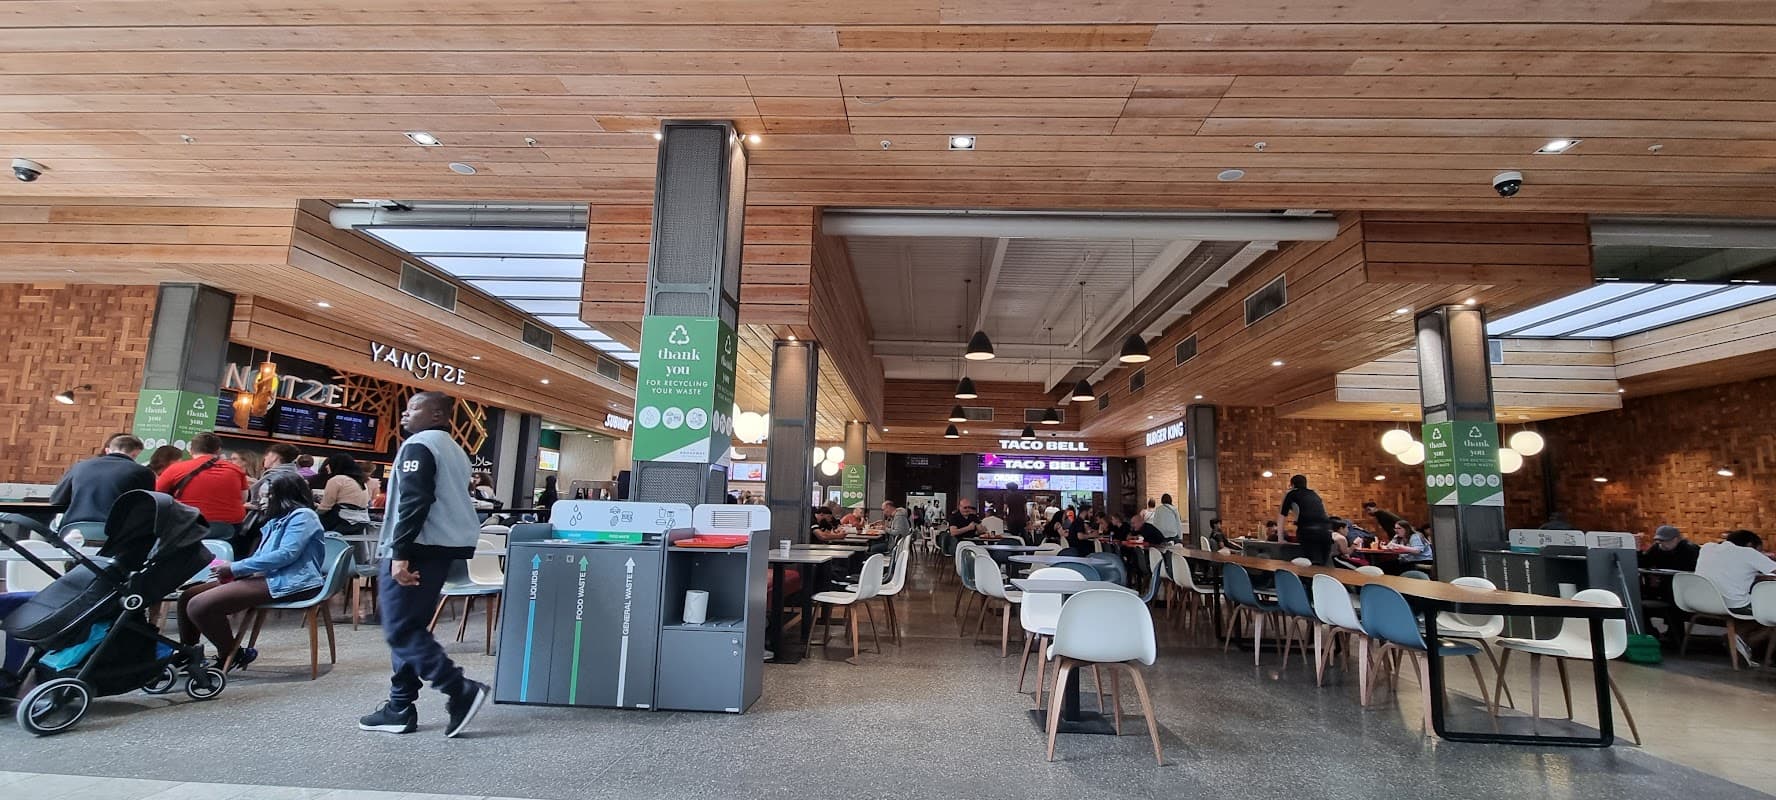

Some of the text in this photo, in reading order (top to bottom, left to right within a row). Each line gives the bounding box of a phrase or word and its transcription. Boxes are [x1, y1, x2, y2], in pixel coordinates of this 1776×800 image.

[658, 348, 700, 361] thank
[665, 365, 690, 377] you
[664, 380, 708, 388] RECYCLING
[676, 388, 701, 396] WASTE
[1146, 421, 1184, 447] BURGER KING
[999, 439, 1089, 451] TACO BELL
[402, 460, 419, 473] 99
[1003, 460, 1091, 471] TACO BELL
[530, 570, 539, 600] LIQUIDS
[576, 572, 586, 620] FOOD WASTE
[622, 573, 633, 635] GENERAL WASTE
